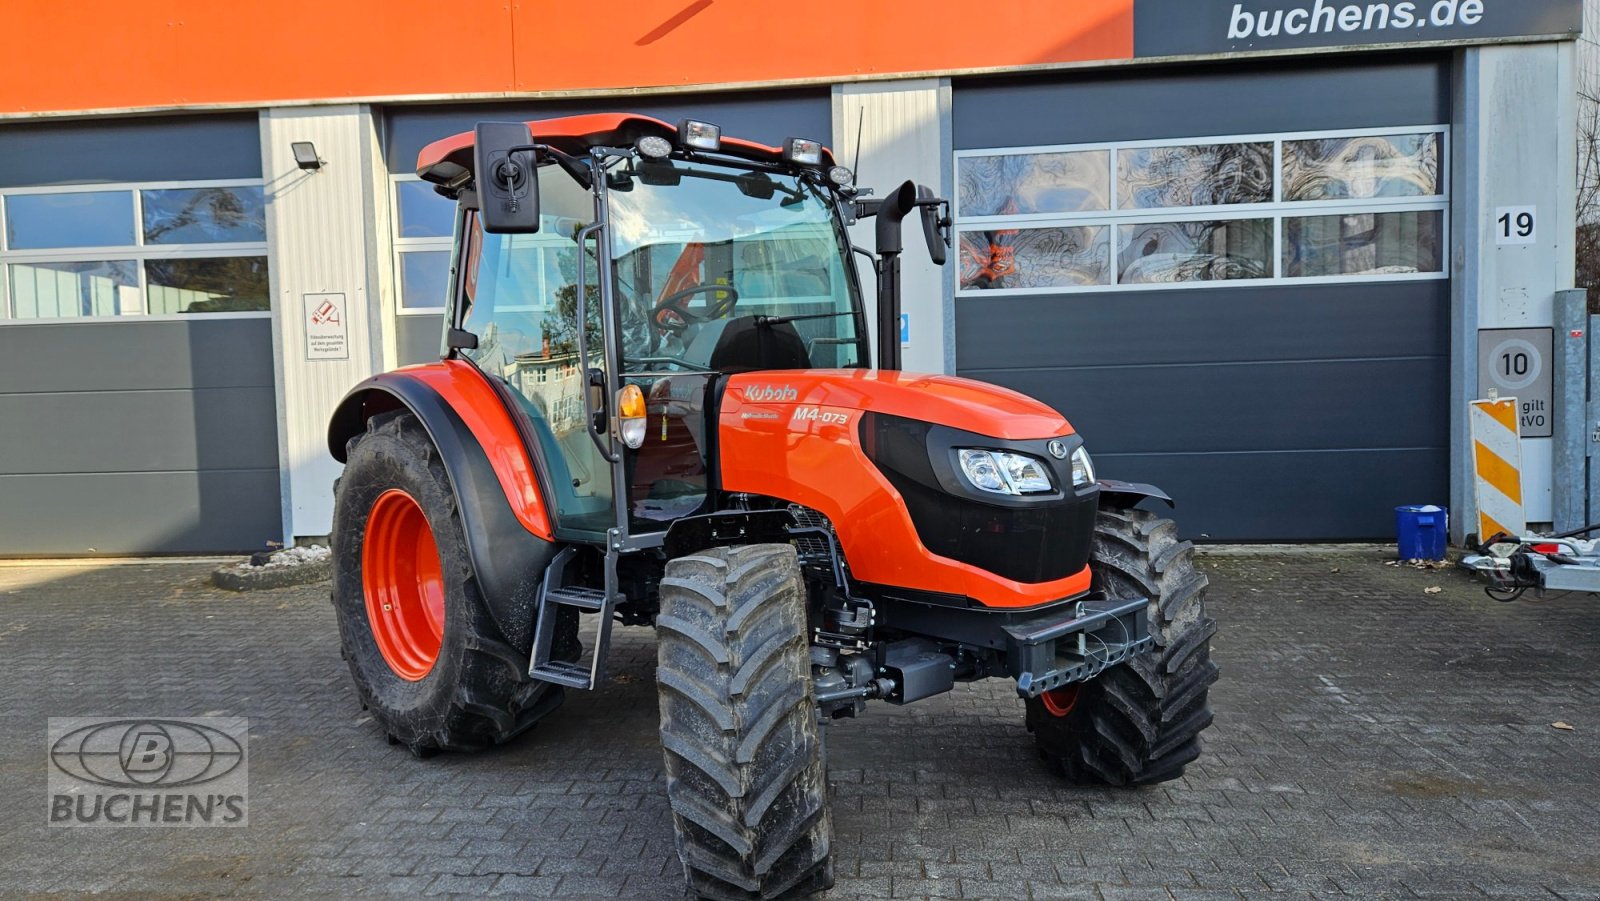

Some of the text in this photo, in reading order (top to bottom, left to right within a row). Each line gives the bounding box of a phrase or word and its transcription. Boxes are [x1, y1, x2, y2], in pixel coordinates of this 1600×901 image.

[1227, 0, 1484, 39] buchens.de
[1498, 212, 1534, 237] 19
[1502, 353, 1528, 375] 10
[745, 384, 798, 401] Kubota
[1522, 399, 1545, 414] gilt
[793, 407, 848, 425] M4-073
[1521, 415, 1545, 427] tVO
